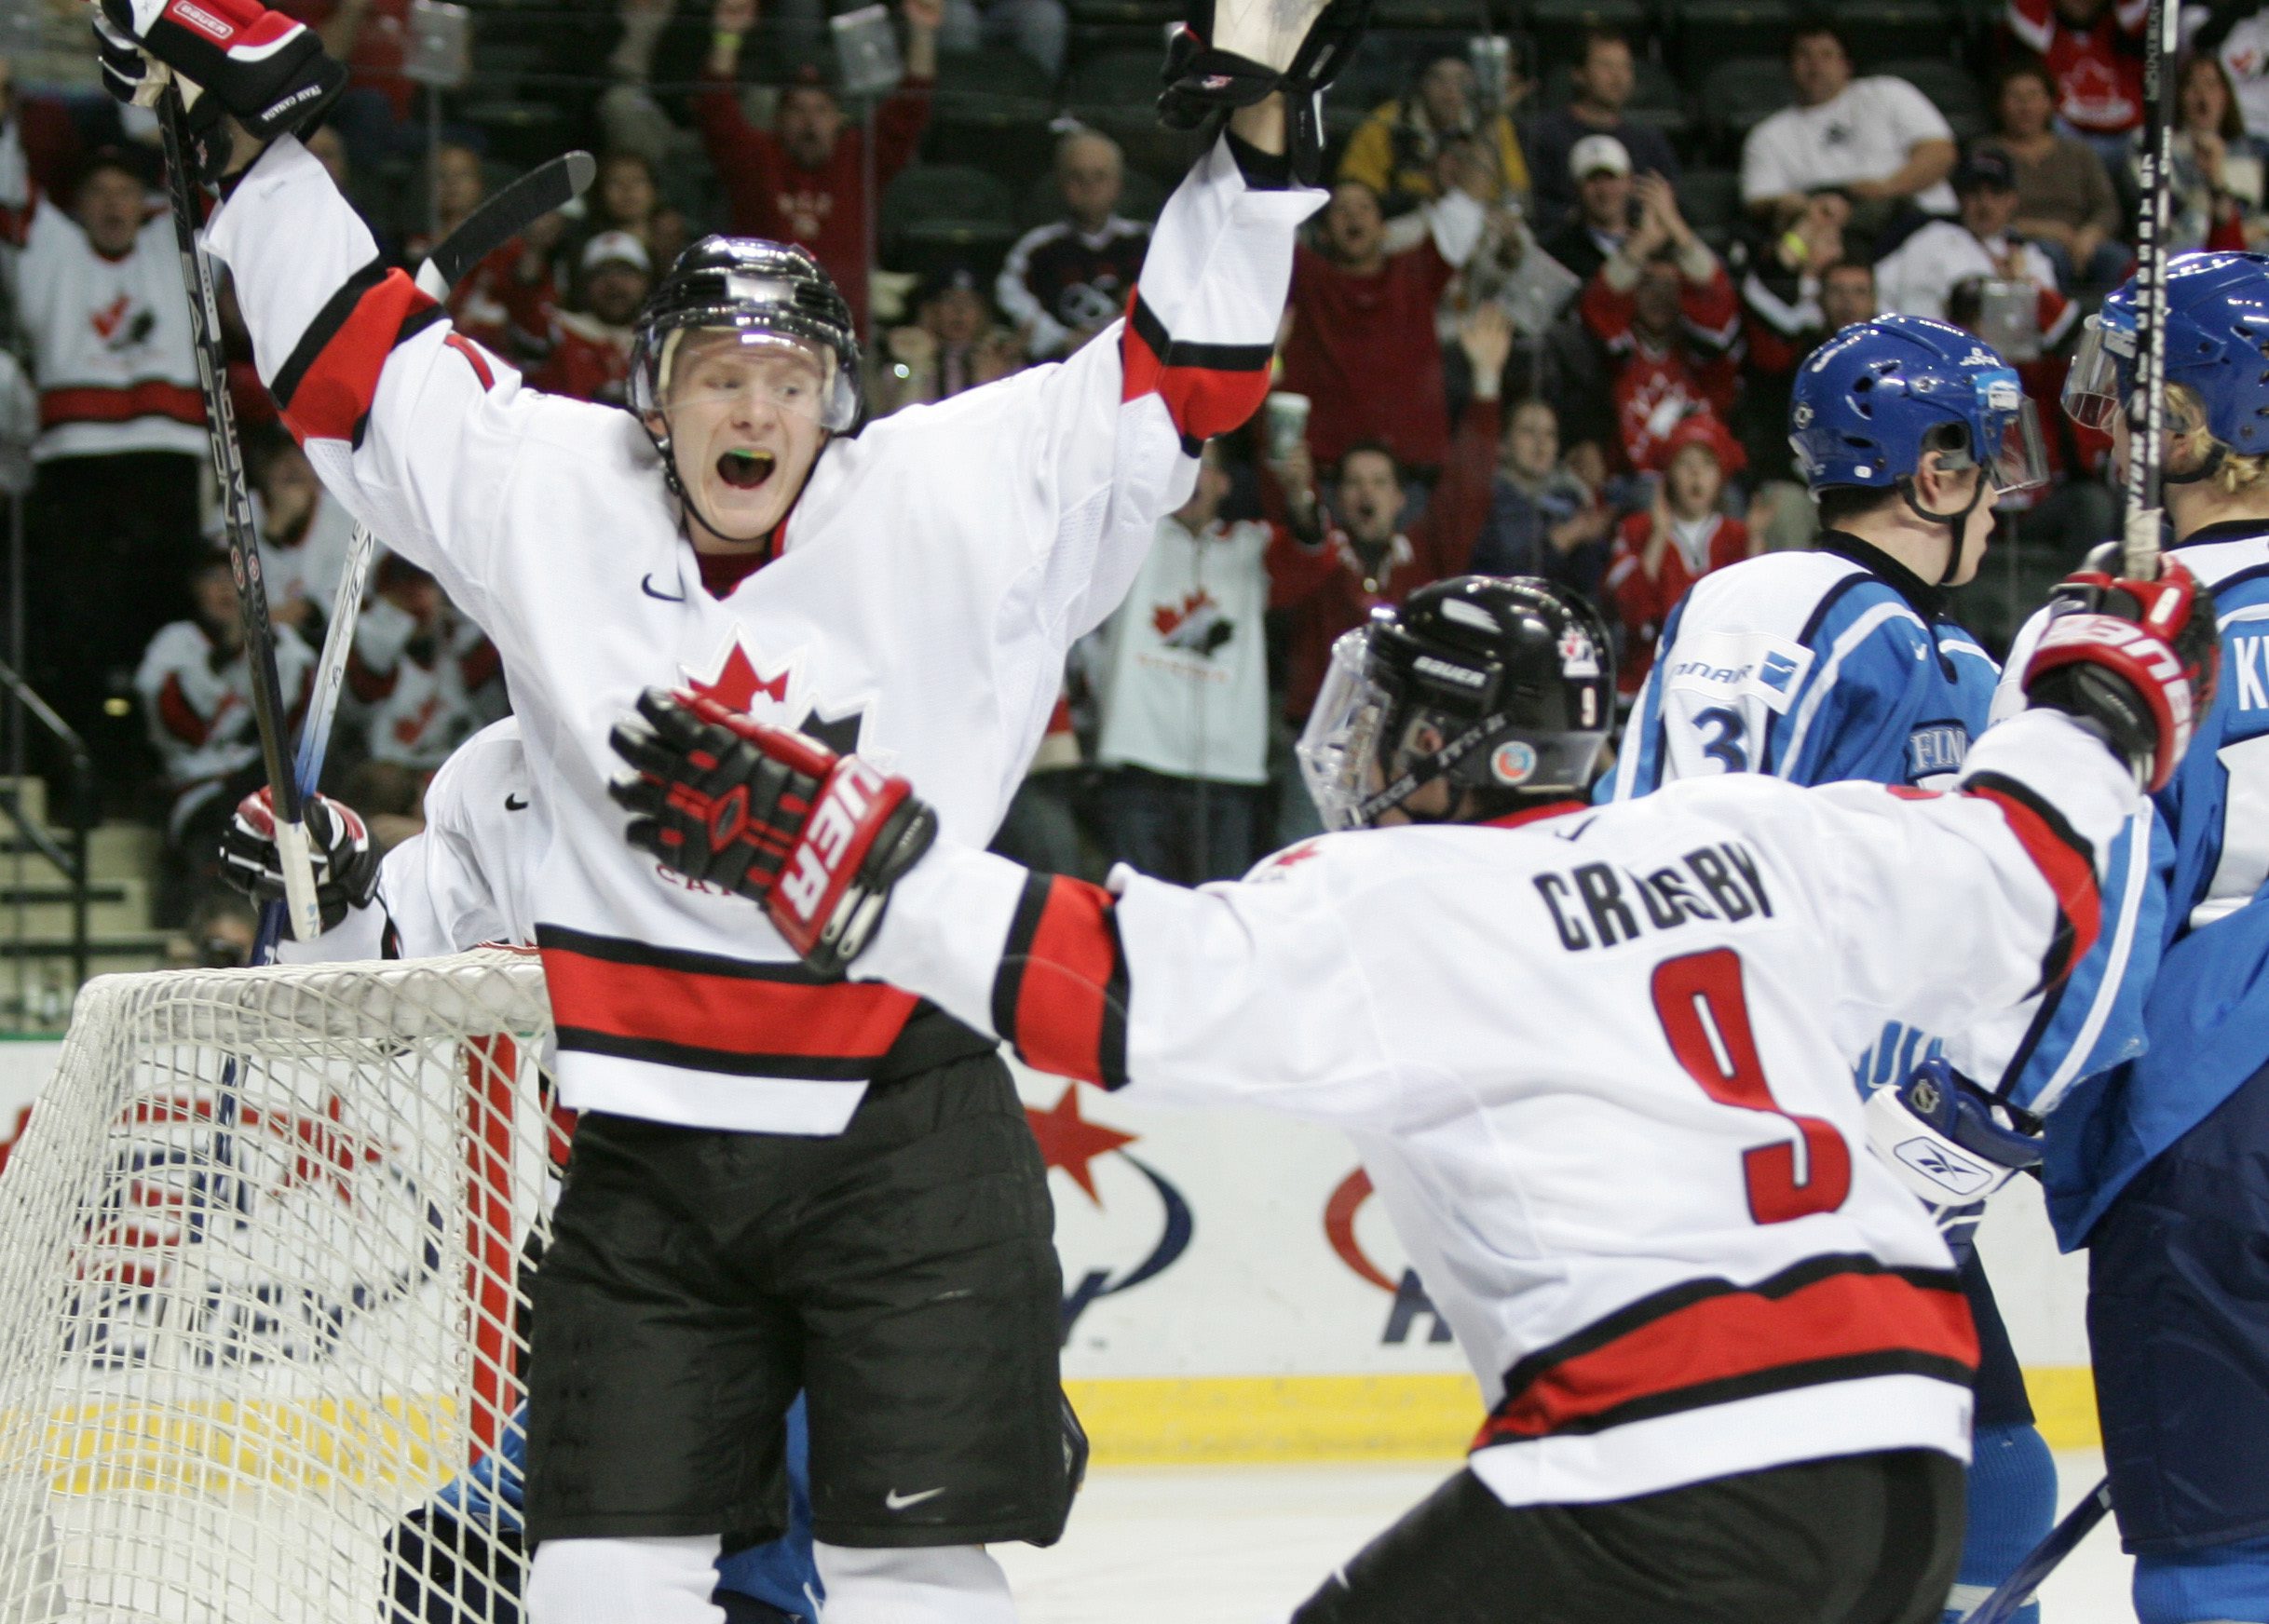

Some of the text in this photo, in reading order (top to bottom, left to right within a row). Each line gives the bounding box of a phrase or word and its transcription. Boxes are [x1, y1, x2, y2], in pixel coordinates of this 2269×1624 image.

[179, 3, 228, 35] BAUER
[261, 84, 322, 122] TEAM CANADA
[181, 251, 236, 524] EASTON
[214, 368, 251, 525] EASTON
[1413, 656, 1488, 688] BAUER
[1581, 687, 1596, 726] 9
[1692, 706, 1747, 773] 3
[1532, 842, 1773, 952] CROSBY
[1650, 944, 1853, 1226] 9
